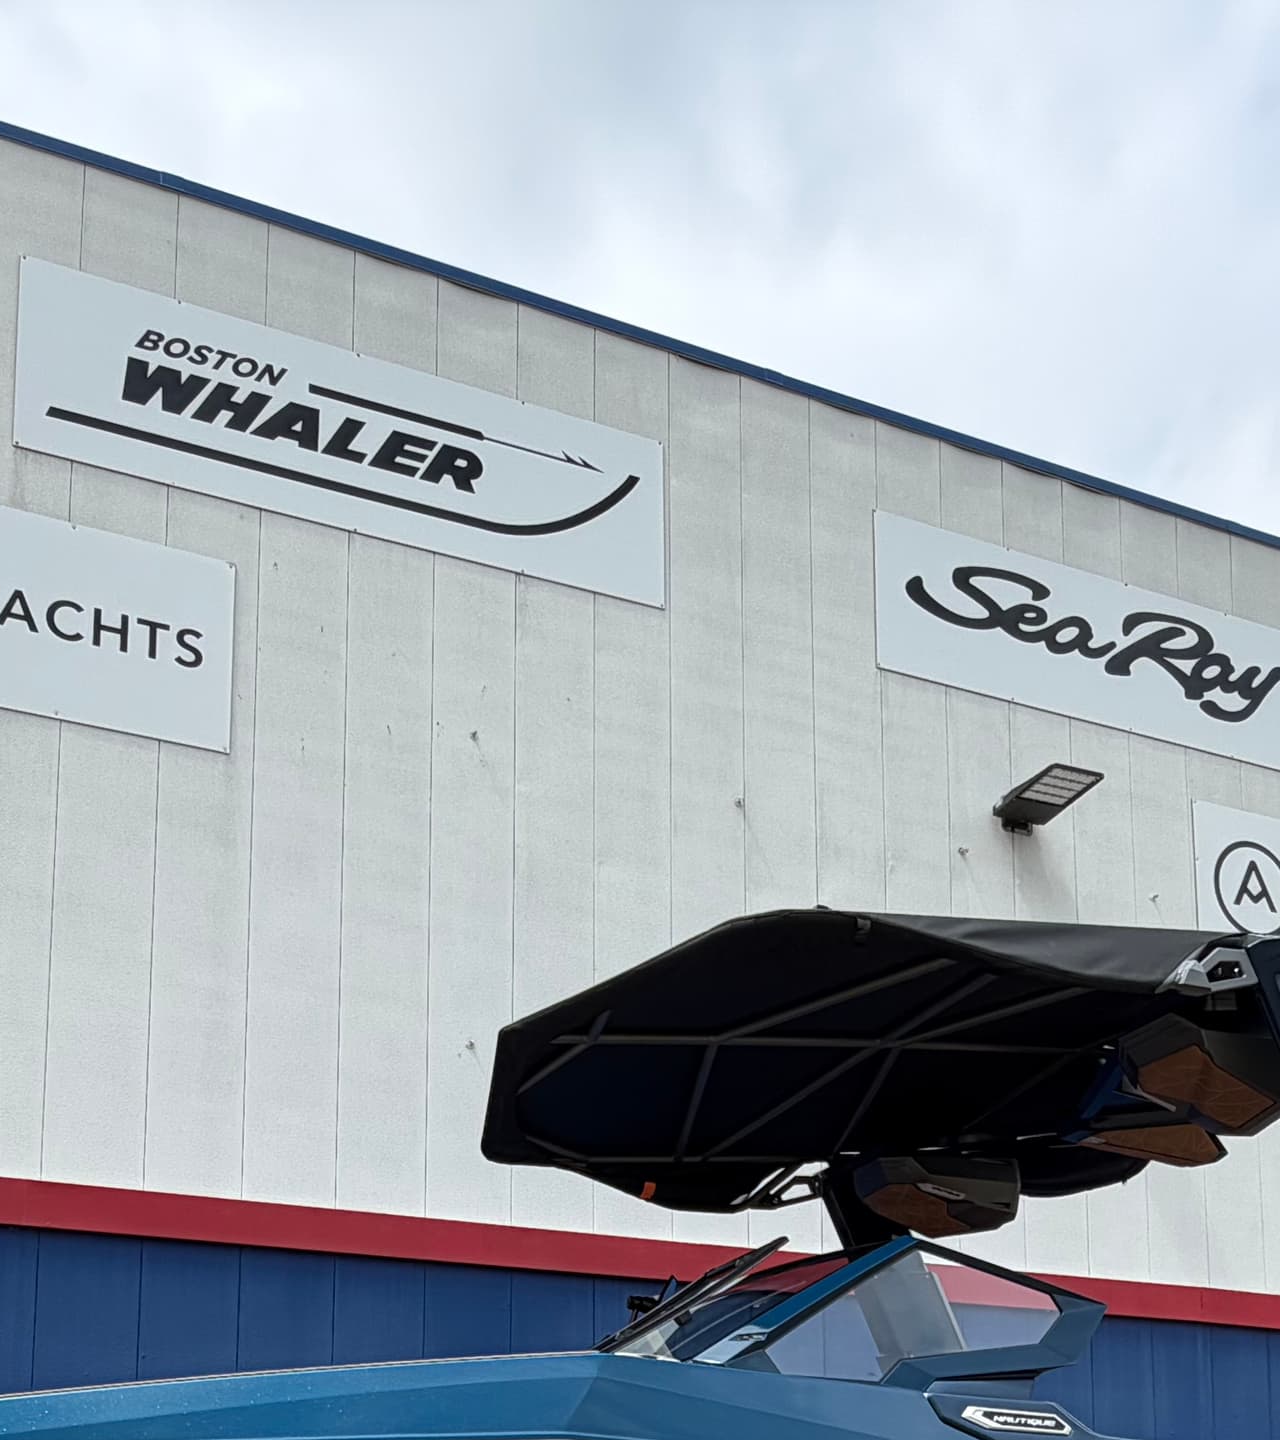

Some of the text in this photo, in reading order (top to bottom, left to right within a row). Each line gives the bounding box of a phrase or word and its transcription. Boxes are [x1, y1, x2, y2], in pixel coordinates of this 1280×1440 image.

[133, 329, 289, 387] BOSTON
[121, 356, 484, 494] WHALER
[905, 566, 1116, 659] Sea
[993, 1415, 1056, 1427] NAUTIQUE
